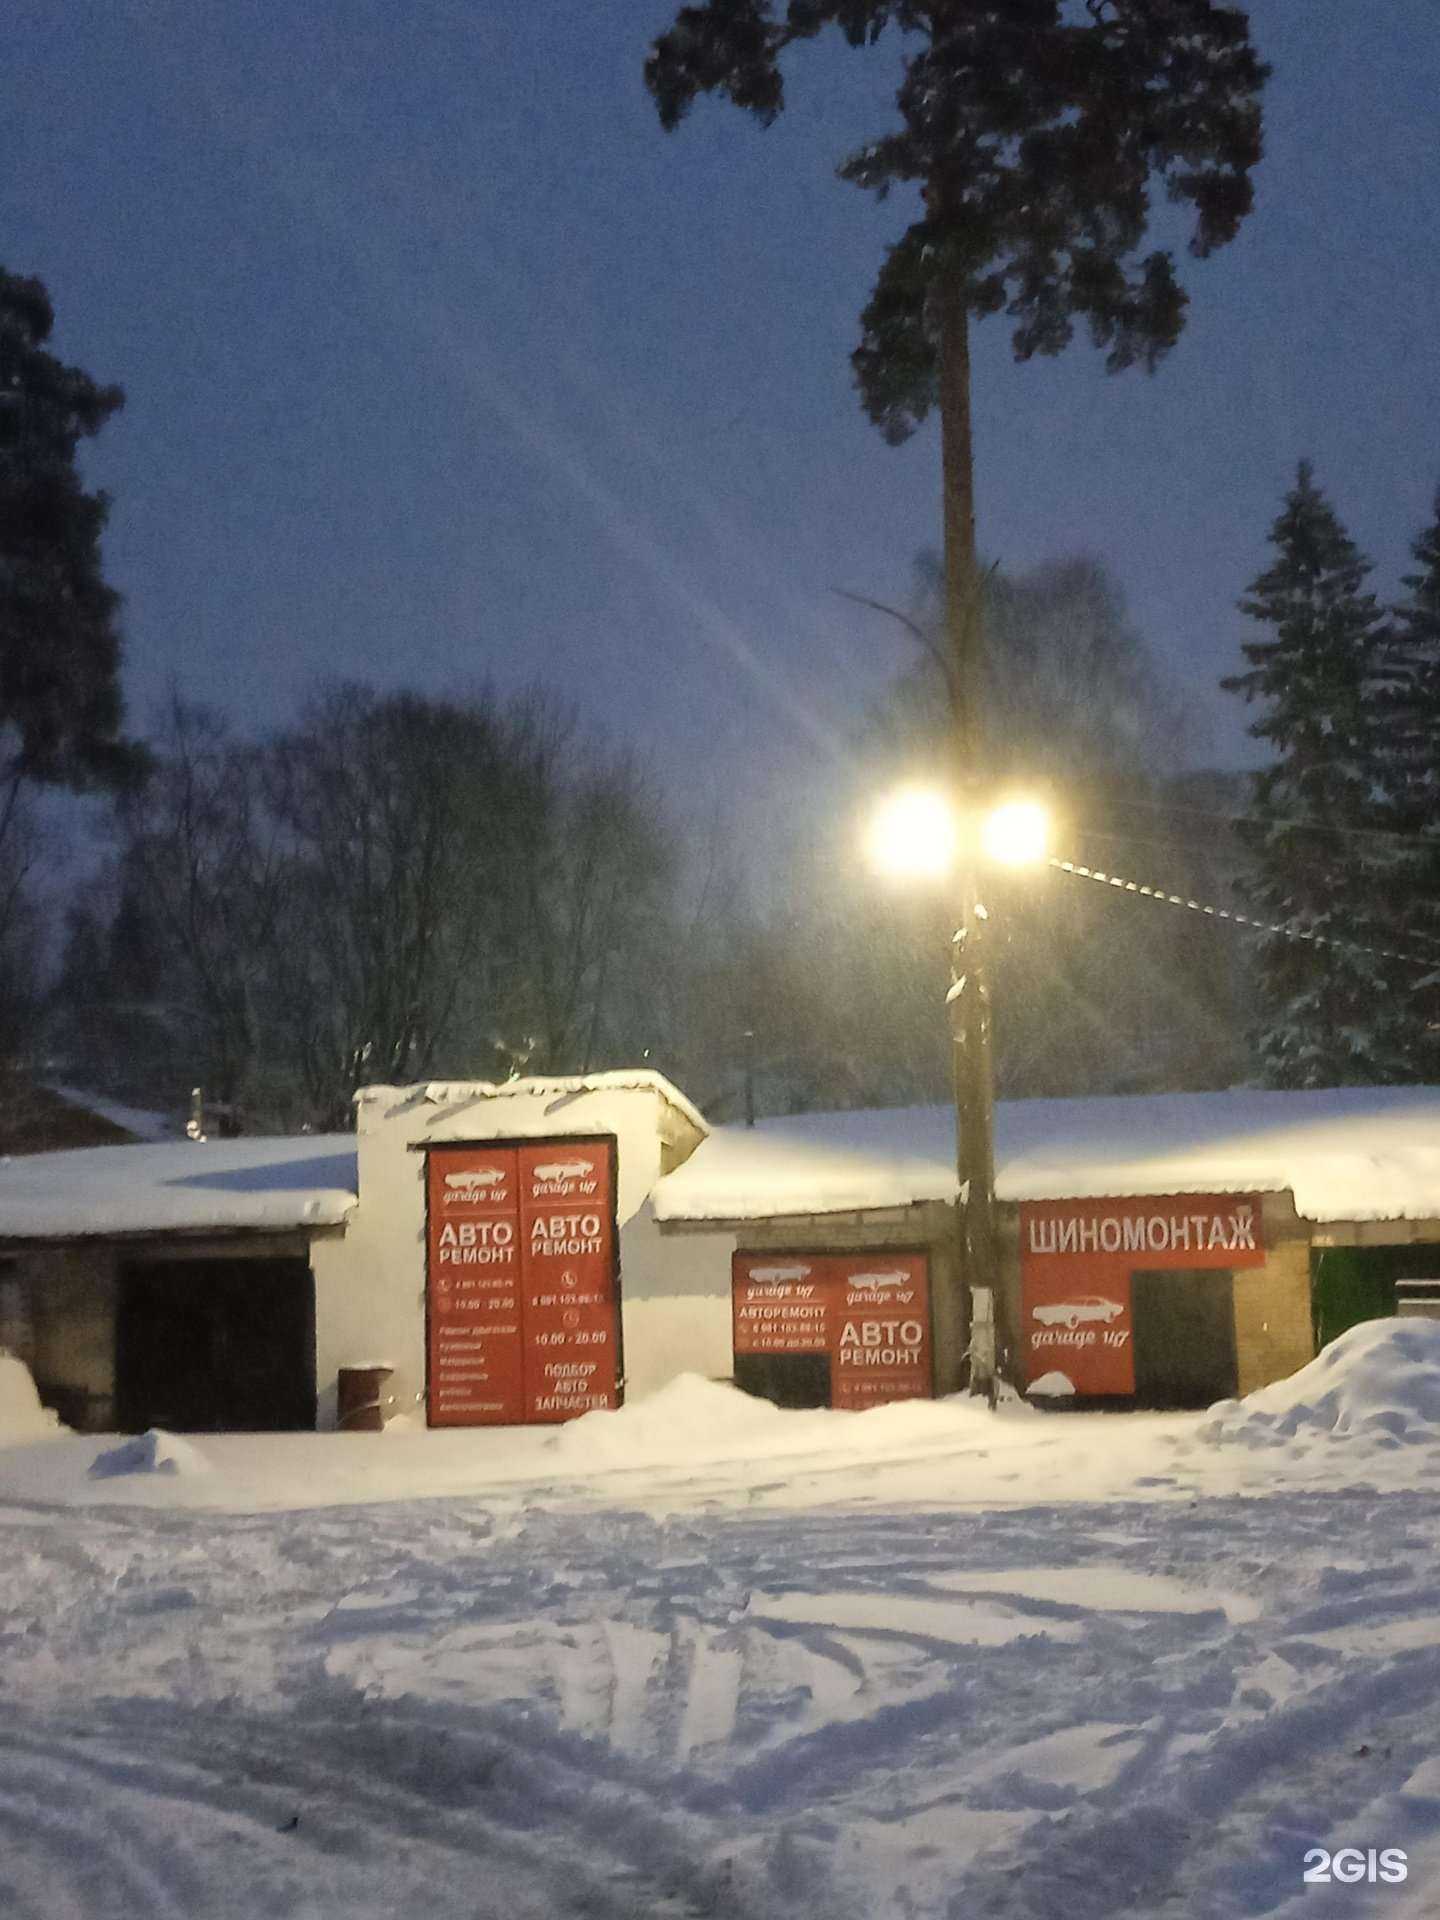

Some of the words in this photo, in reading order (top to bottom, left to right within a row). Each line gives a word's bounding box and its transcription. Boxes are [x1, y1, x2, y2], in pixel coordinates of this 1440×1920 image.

[443, 1187, 487, 1205] garage
[532, 1179, 575, 1198] garage
[439, 1221, 513, 1247] АВТО
[531, 1214, 601, 1240] АВТО
[1029, 1215, 1257, 1254] ШИНОМОНТАЖ
[439, 1246, 515, 1266] РЕМОНТ
[531, 1238, 603, 1257] РЕМОНТ
[747, 1283, 793, 1301] garage
[846, 1289, 891, 1306] garage
[739, 1307, 826, 1320] АВТОРЕМОНТ
[839, 1321, 923, 1347] АВТО
[1031, 1329, 1096, 1349] garage
[839, 1347, 922, 1366] РЕМОНТ
[544, 1363, 596, 1378] ПОДБОР
[553, 1379, 588, 1393] АВТО
